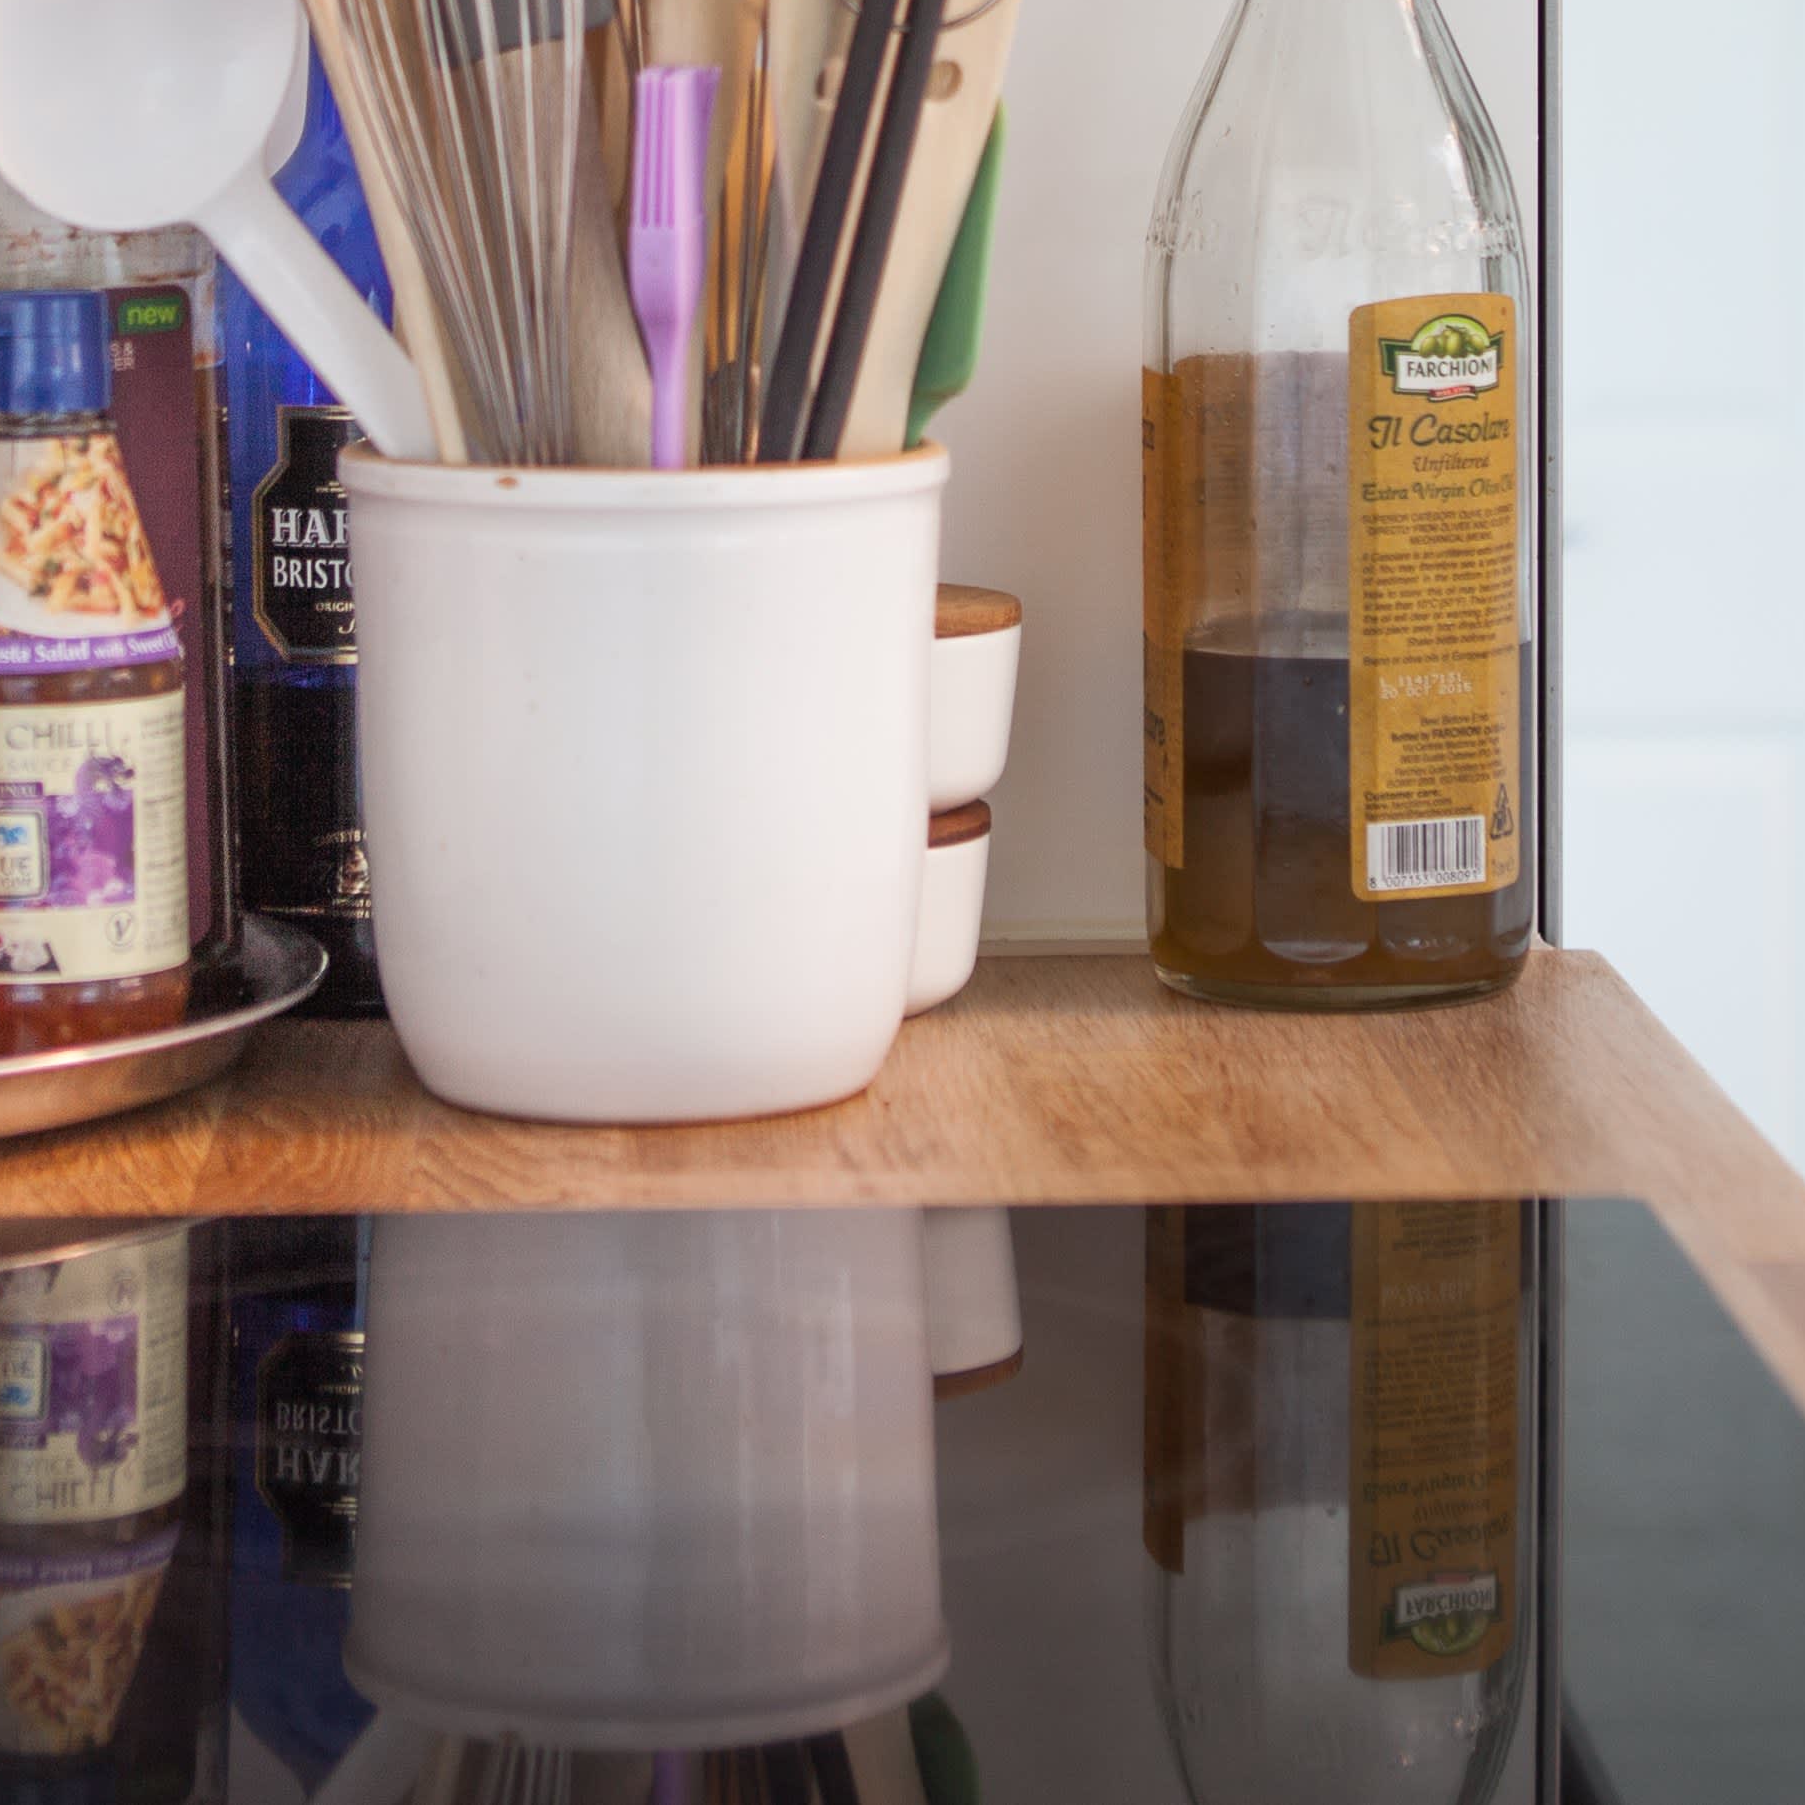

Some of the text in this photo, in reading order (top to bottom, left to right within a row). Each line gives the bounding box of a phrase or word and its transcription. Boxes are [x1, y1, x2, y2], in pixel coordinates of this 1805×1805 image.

[126, 305, 179, 326] new
[1368, 415, 1402, 450] Il
[1361, 482, 1408, 502] Extra
[1412, 481, 1465, 504] Virgin
[34, 635, 90, 664] Salad
